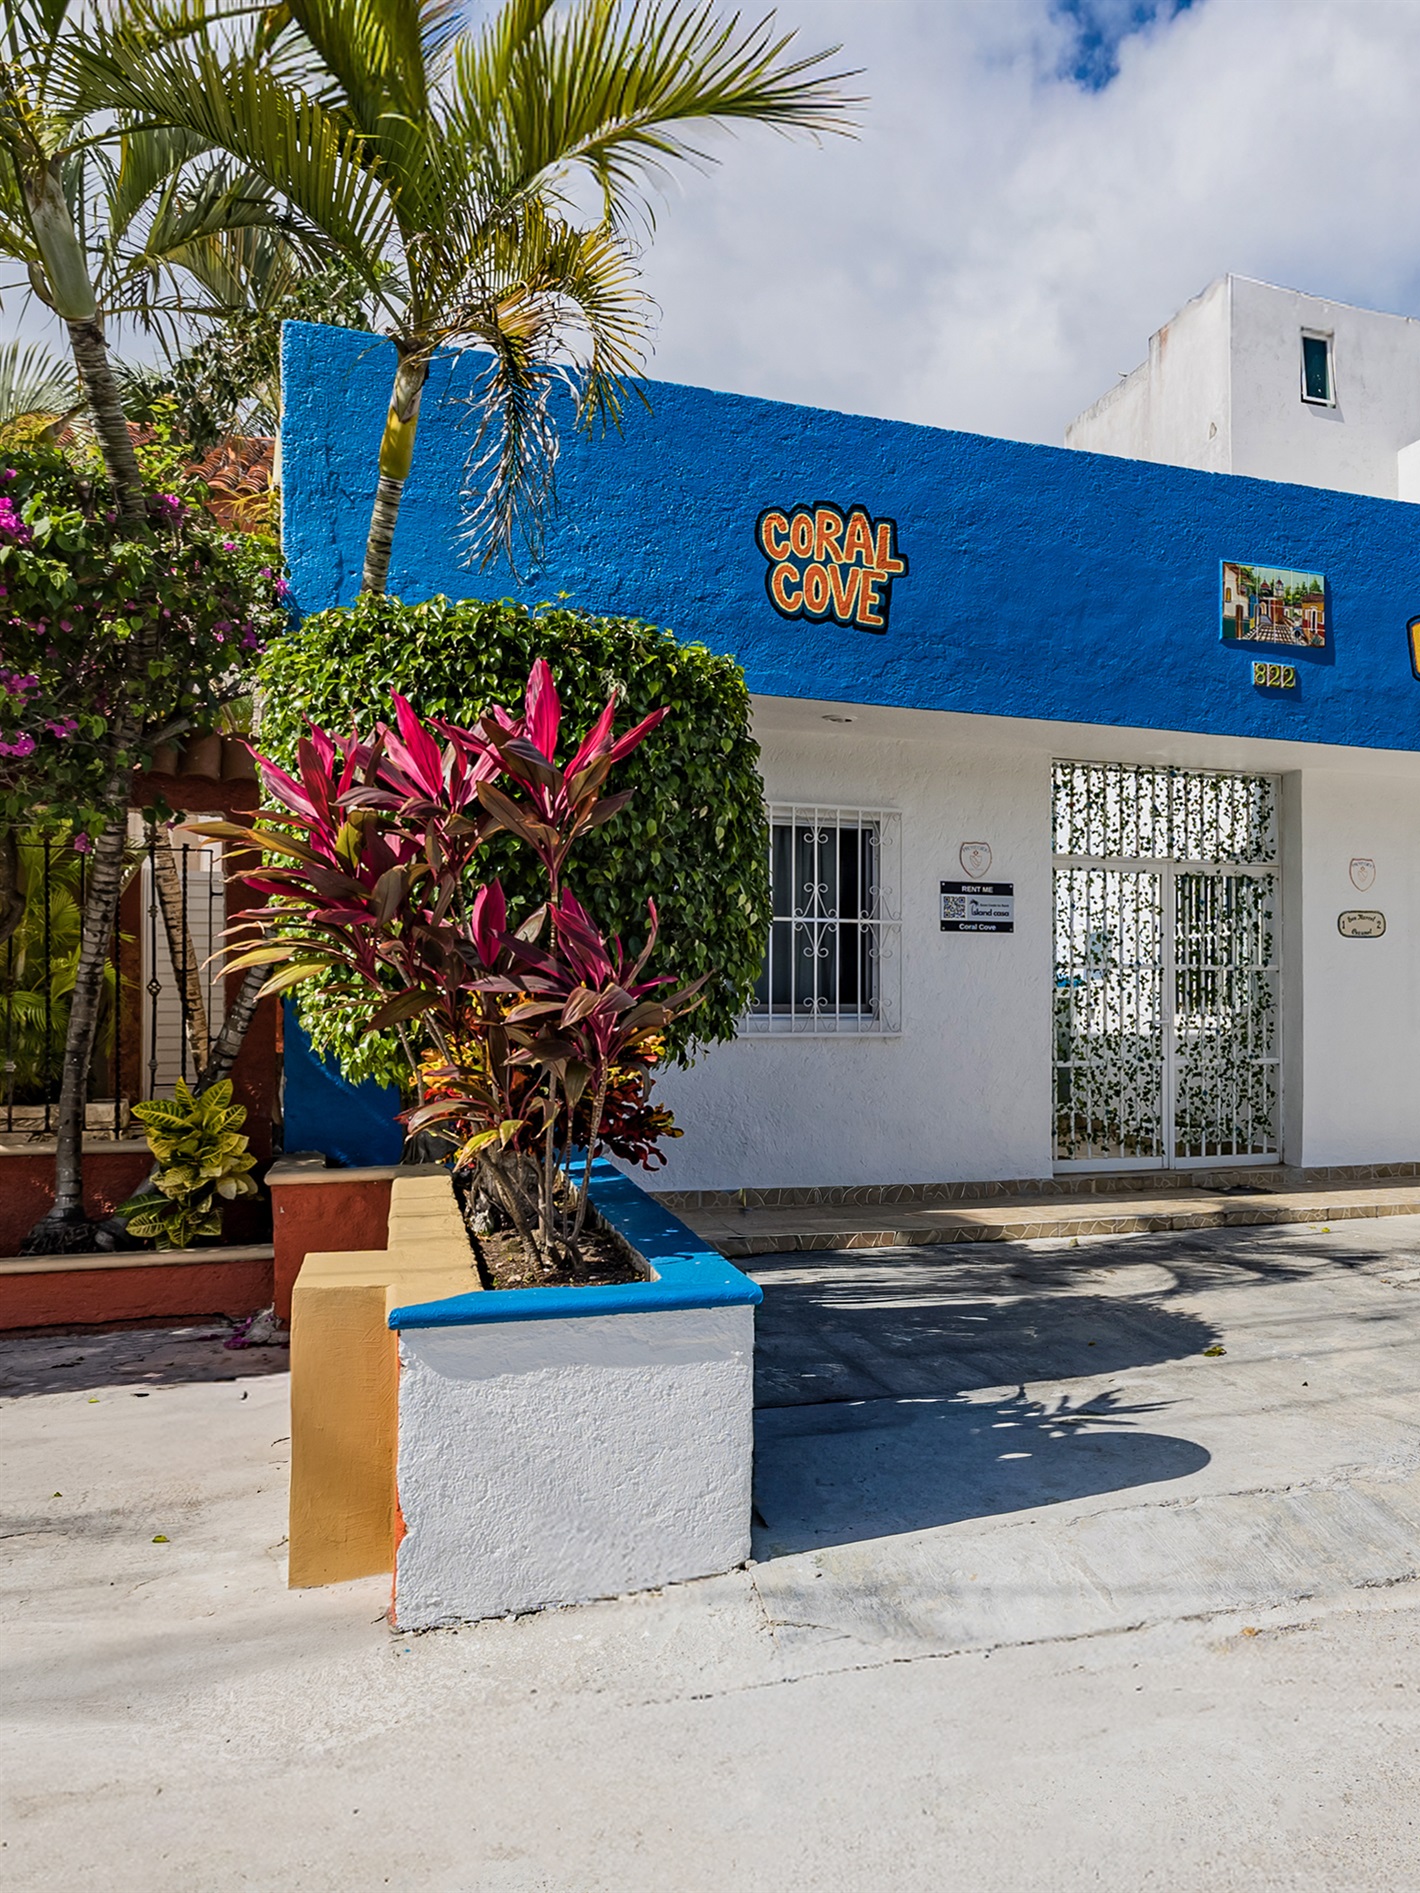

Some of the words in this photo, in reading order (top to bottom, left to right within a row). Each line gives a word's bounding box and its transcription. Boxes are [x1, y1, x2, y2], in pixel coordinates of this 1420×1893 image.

[761, 508, 904, 573] CORAL
[771, 562, 888, 626] COVE
[1254, 663, 1296, 688] 822
[961, 885, 981, 893] RENT
[982, 886, 994, 894] ME
[958, 923, 978, 931] Coral
[978, 923, 997, 931] Cove
